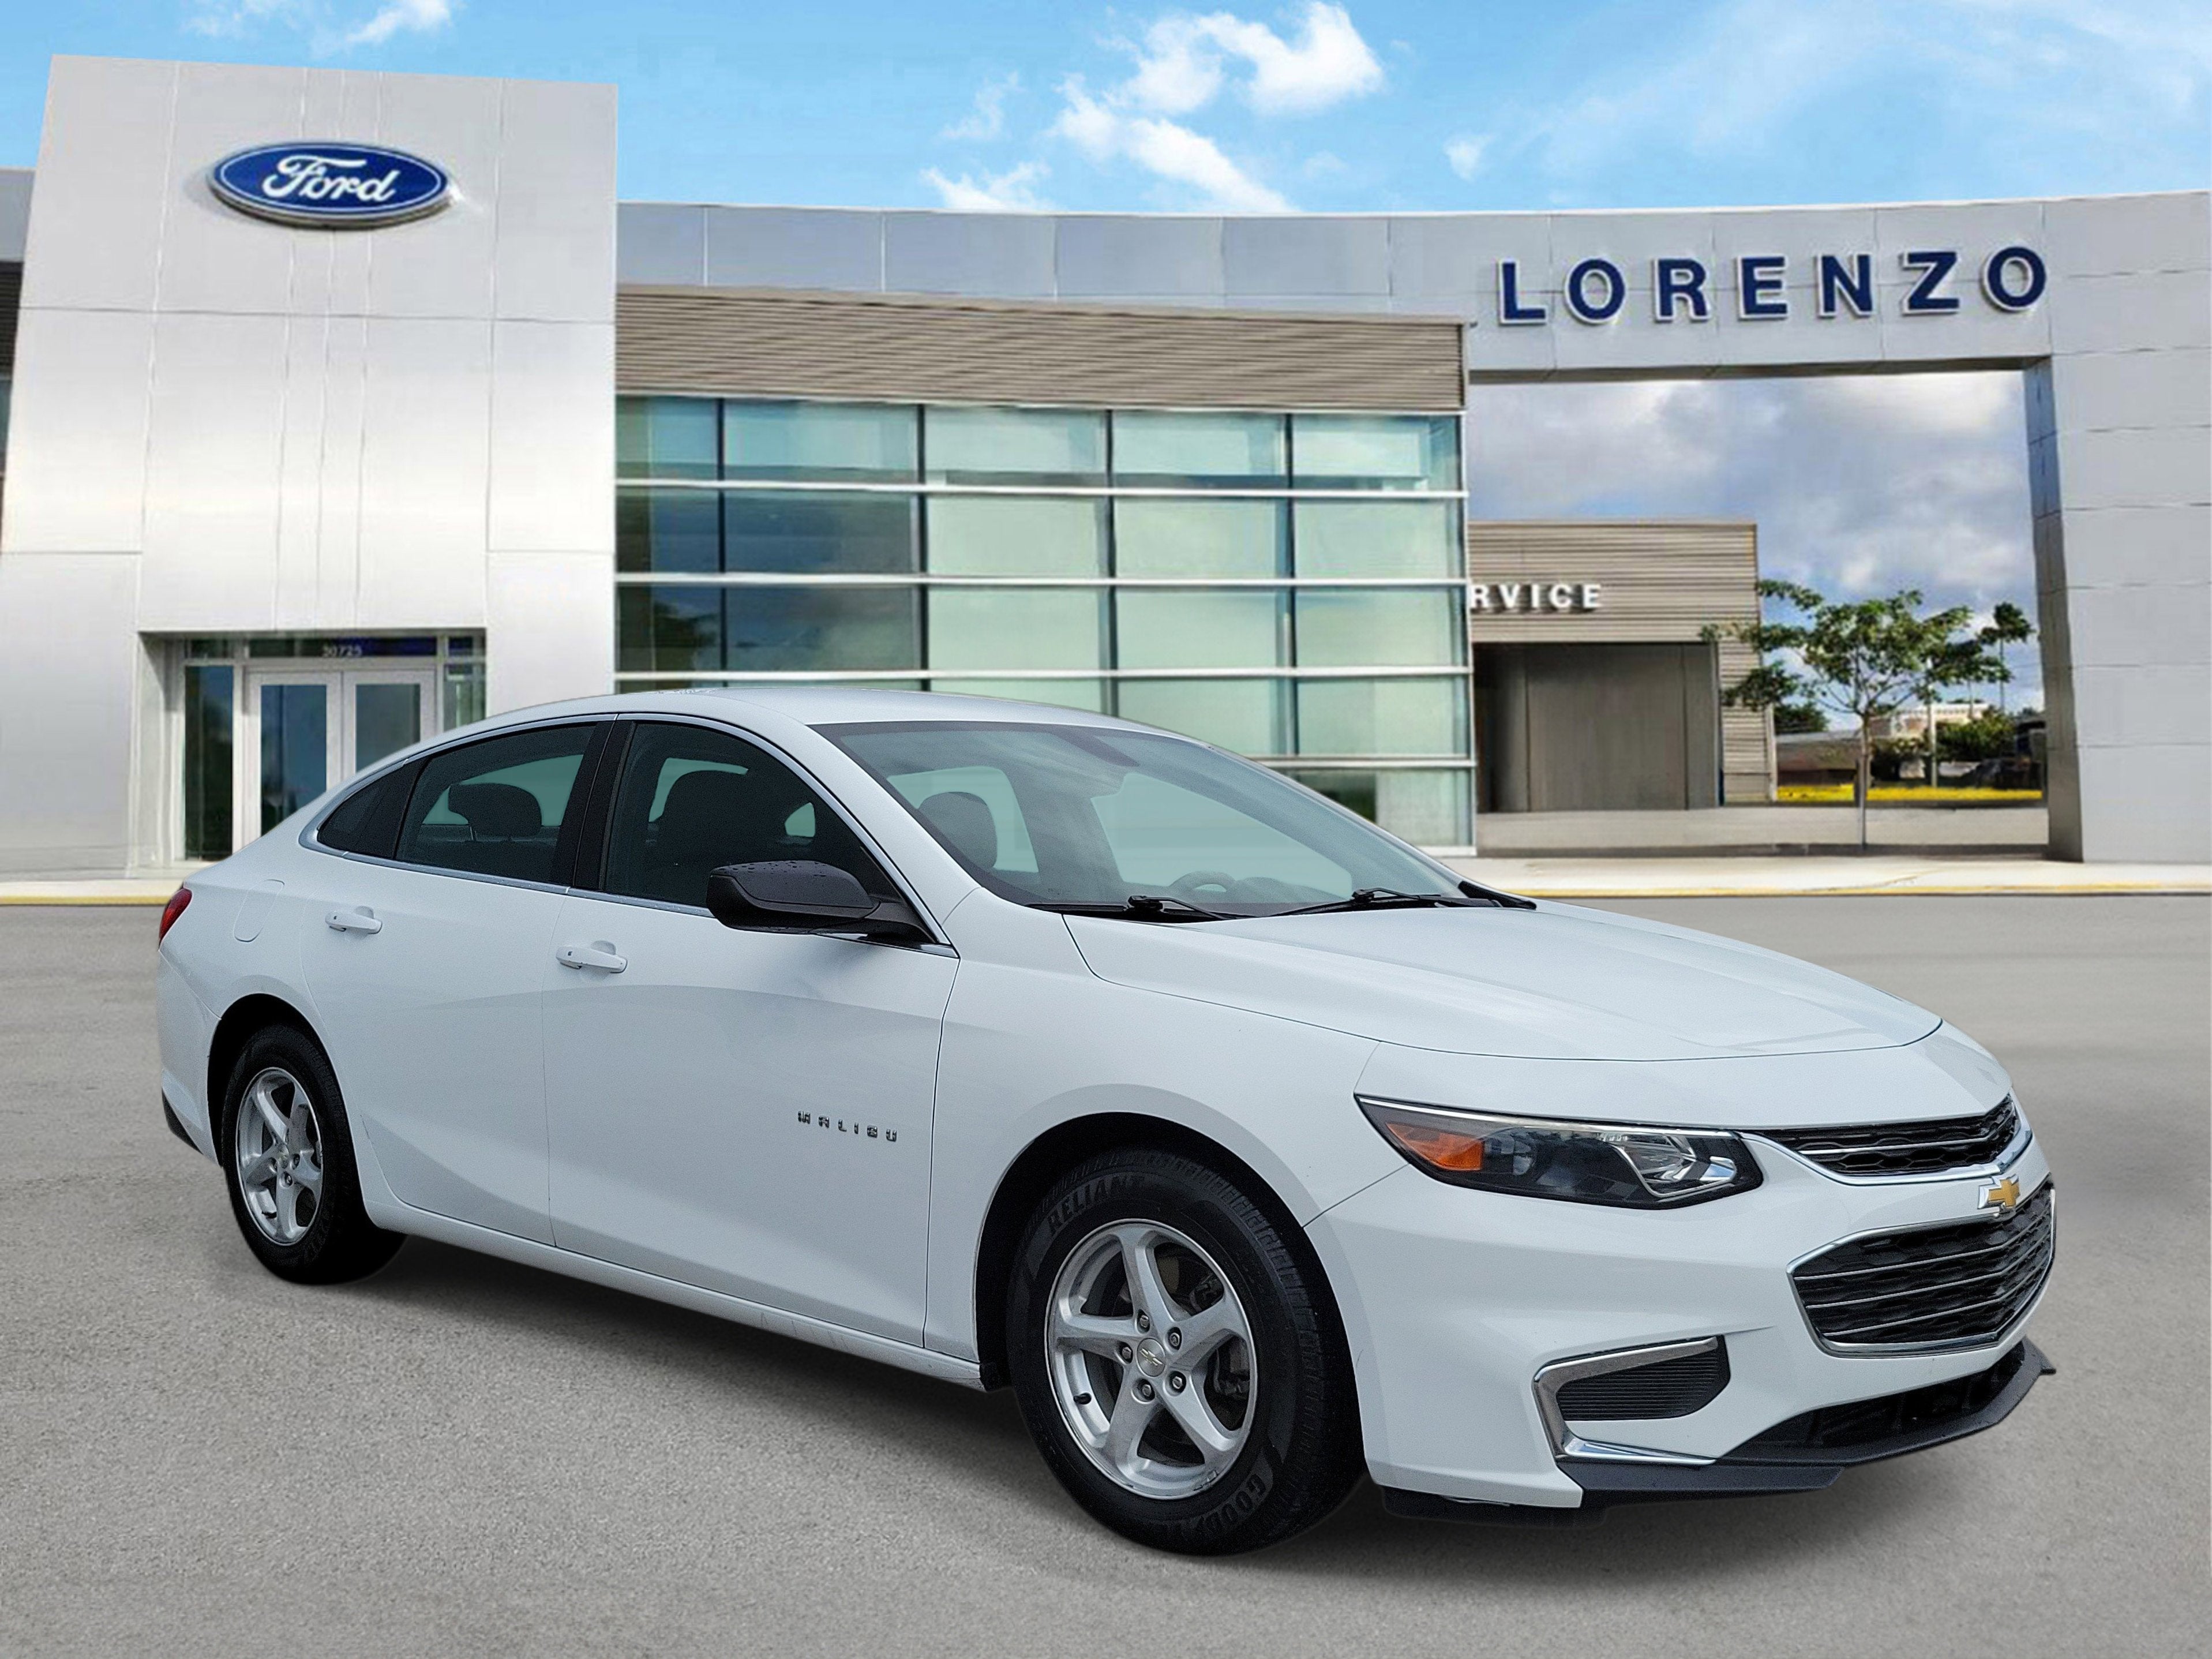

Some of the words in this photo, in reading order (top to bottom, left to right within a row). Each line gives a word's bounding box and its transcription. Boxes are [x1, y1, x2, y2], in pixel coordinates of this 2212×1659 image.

[262, 154, 400, 201] Ford
[1499, 245, 2047, 325] LORENZO
[1469, 583, 1602, 609] RVICE
[798, 1110, 897, 1143] MALIBU
